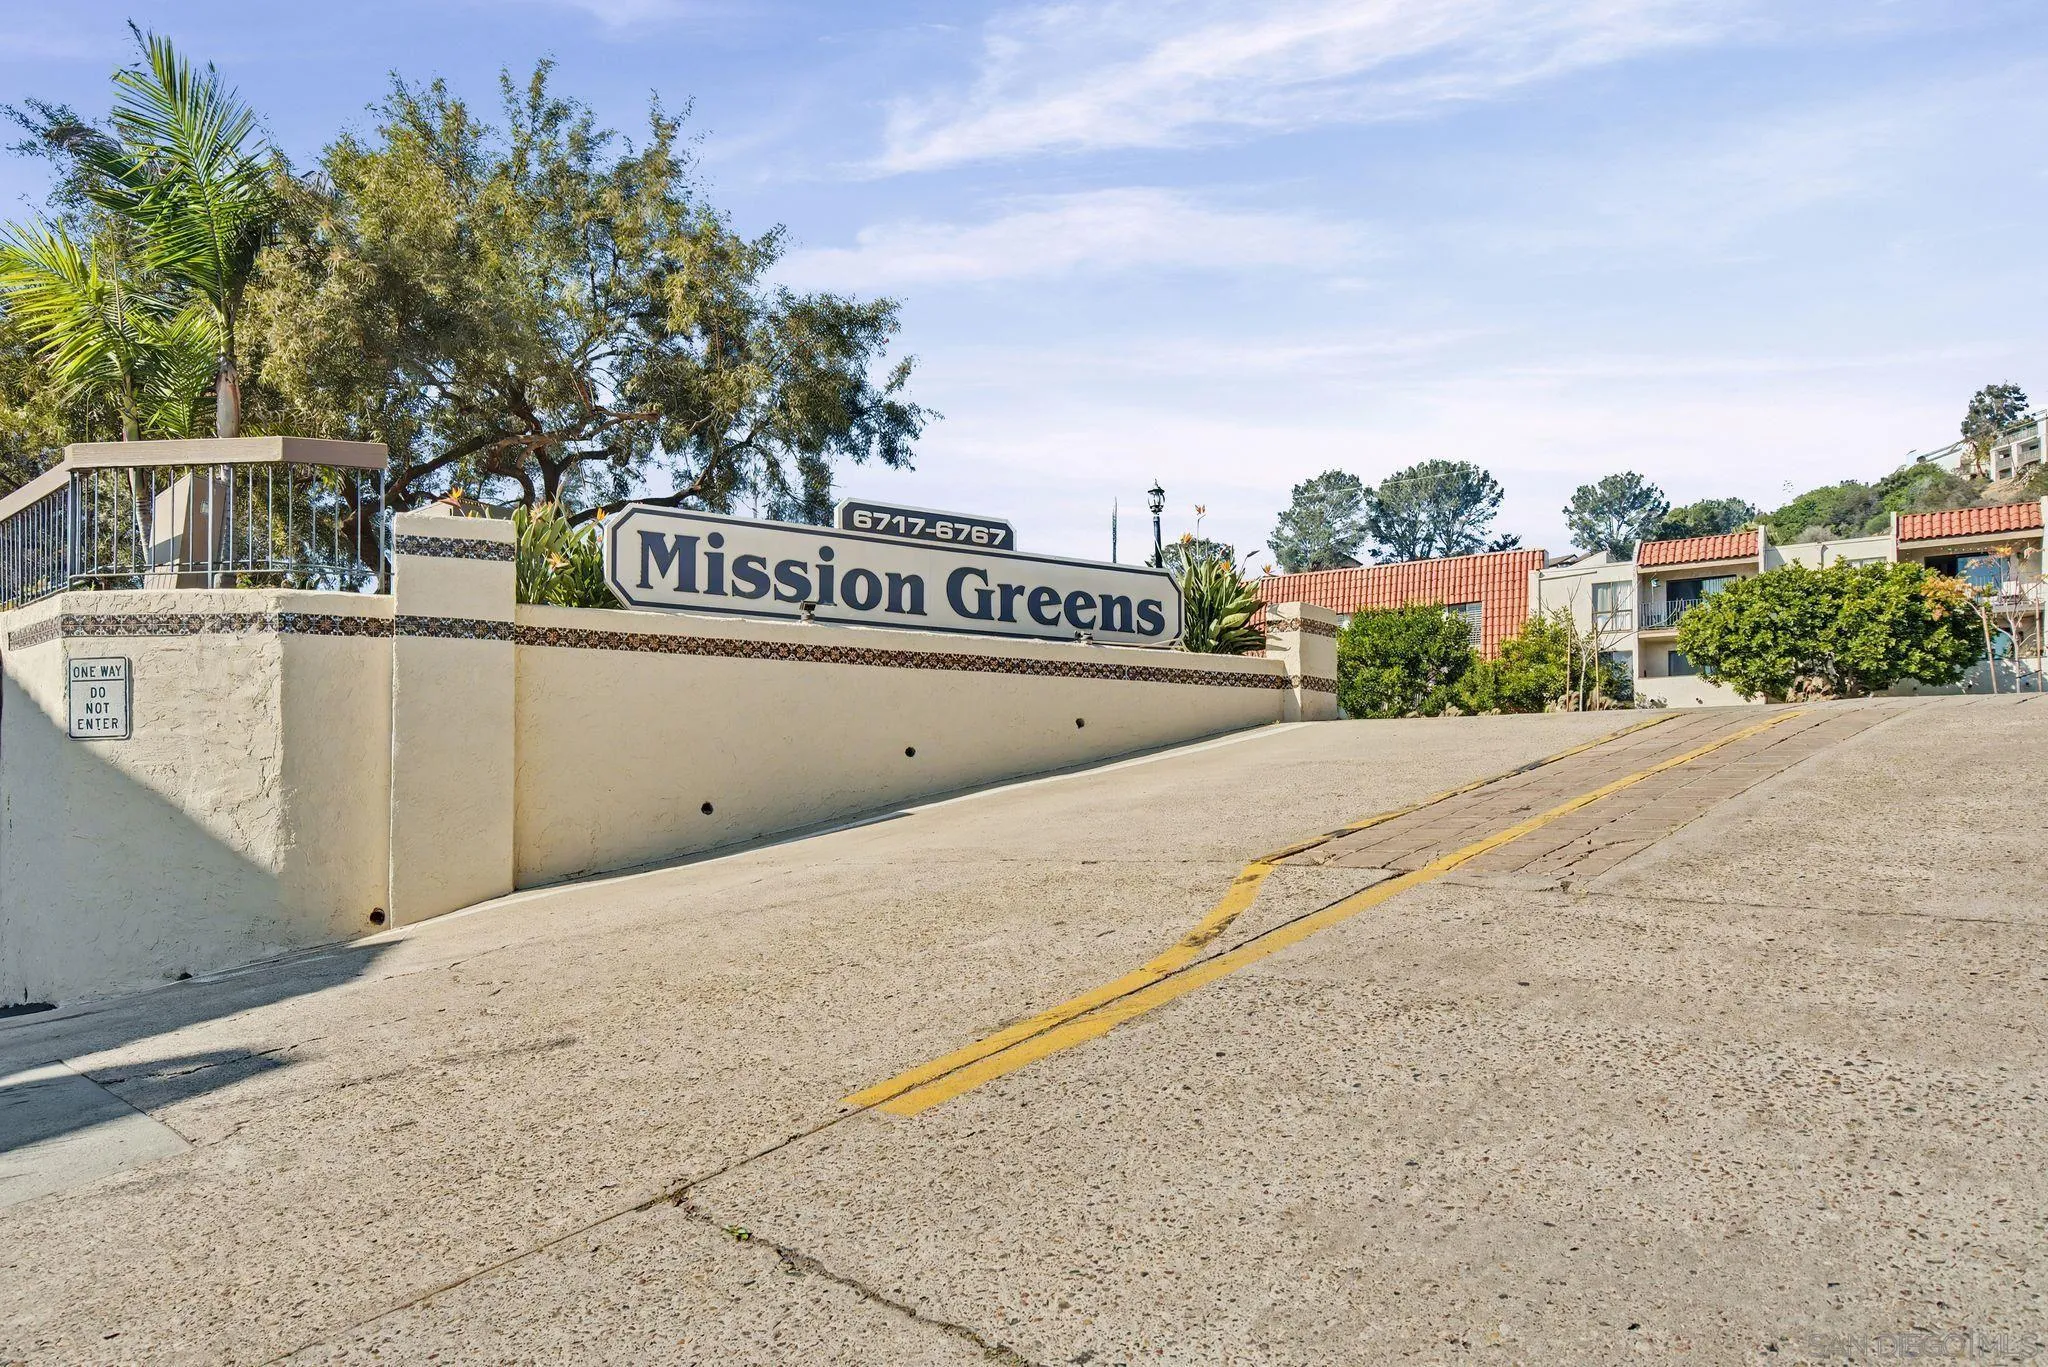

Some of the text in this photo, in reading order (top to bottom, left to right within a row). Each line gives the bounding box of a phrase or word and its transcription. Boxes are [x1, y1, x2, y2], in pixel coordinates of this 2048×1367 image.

[852, 508, 1007, 546] 6717-6767
[636, 530, 1166, 637] Mission Greens
[73, 665, 122, 678] ONE WAY
[90, 687, 106, 698] DO
[86, 702, 110, 714] NOT
[77, 718, 119, 730] ENTER
